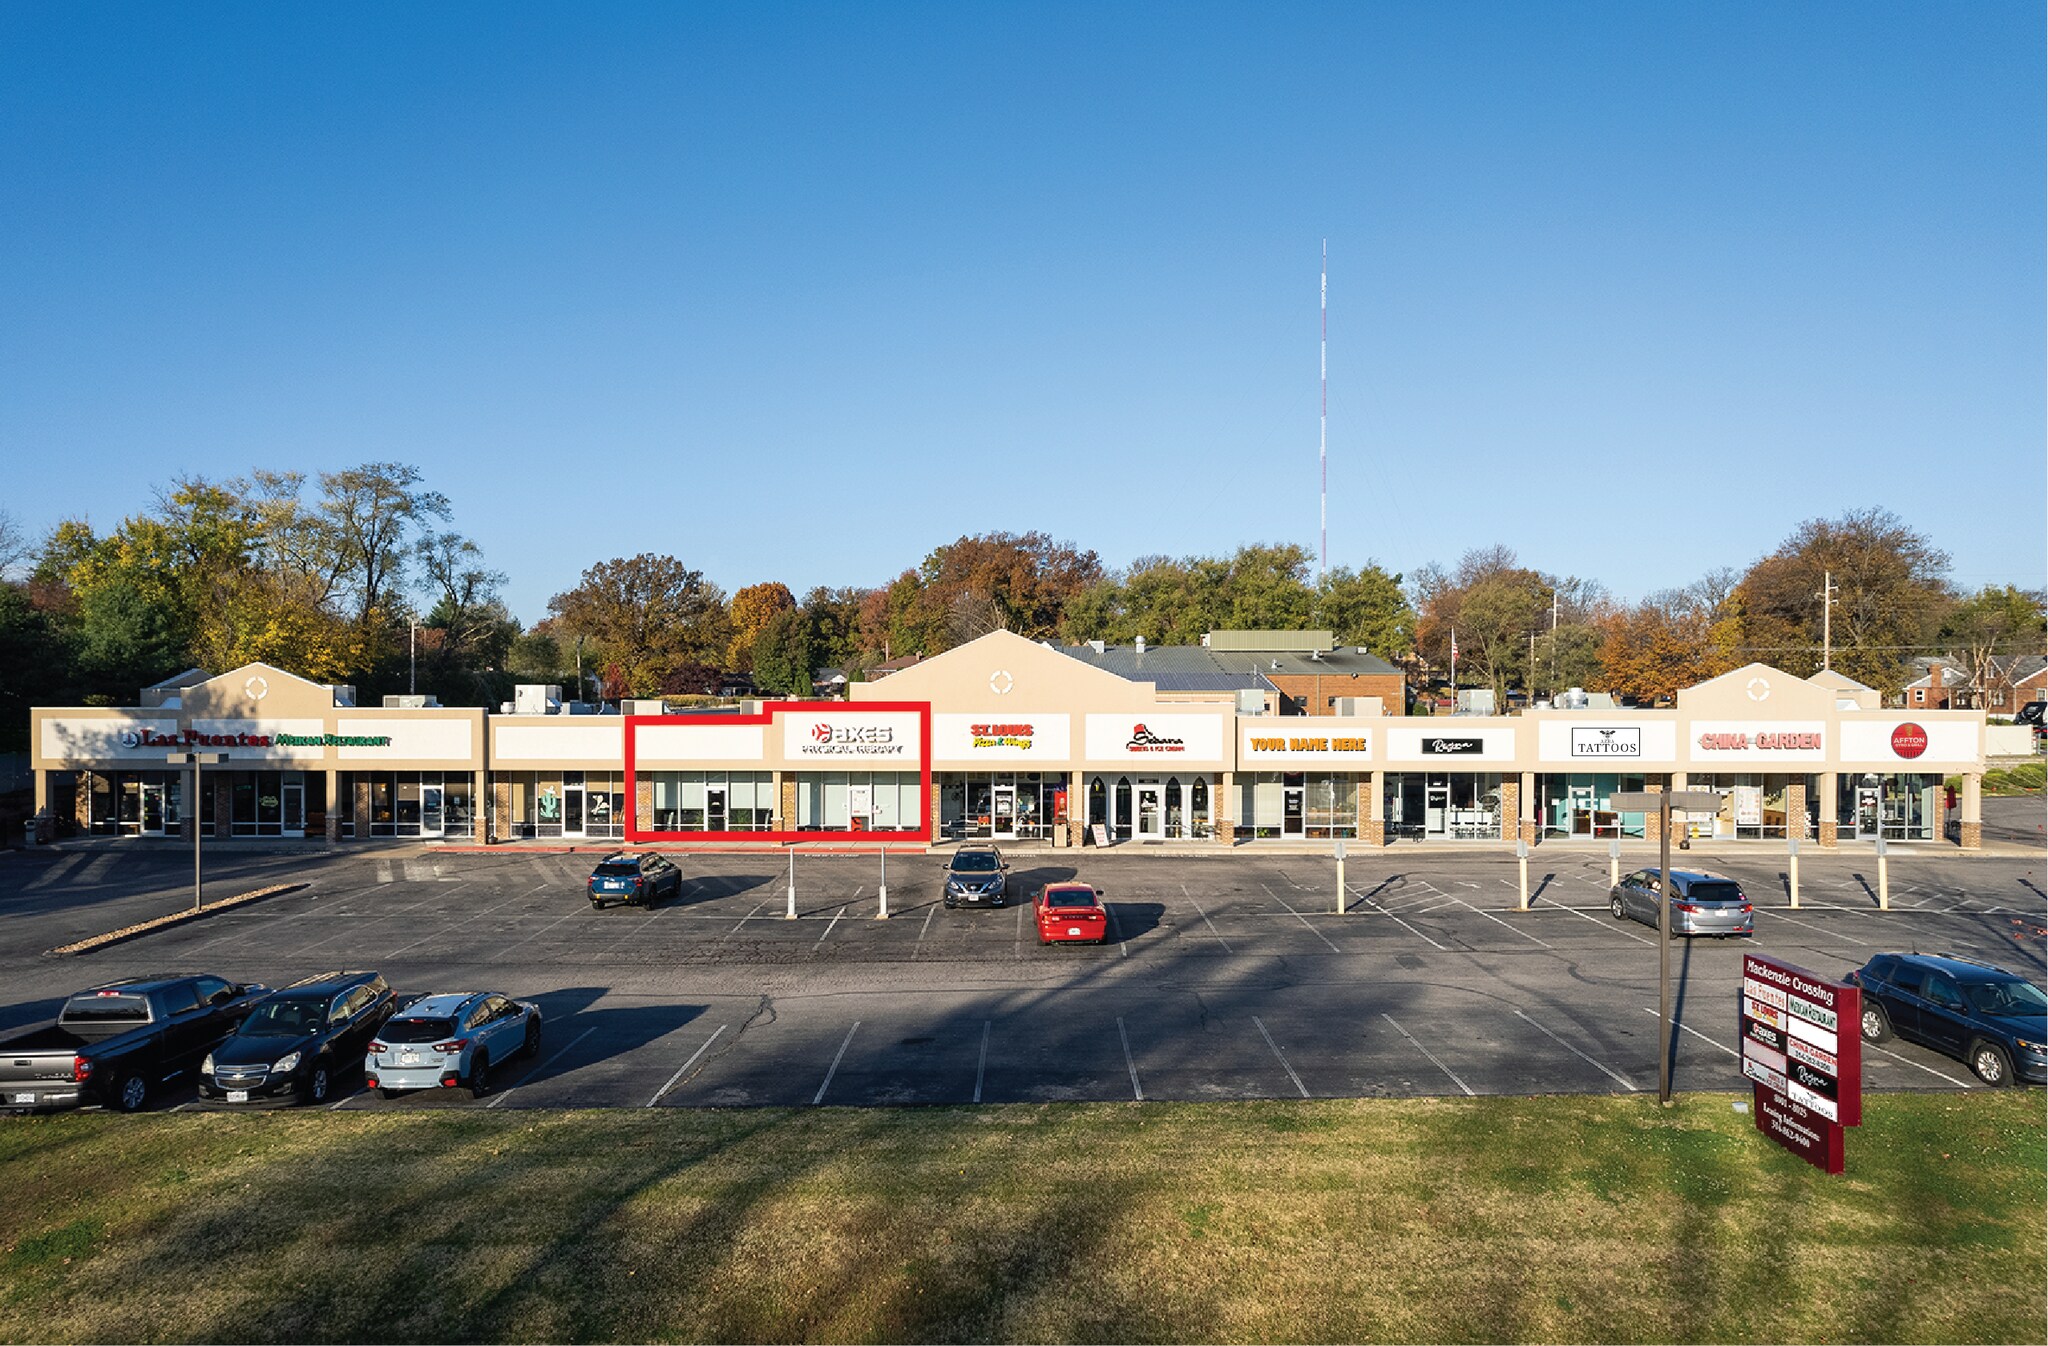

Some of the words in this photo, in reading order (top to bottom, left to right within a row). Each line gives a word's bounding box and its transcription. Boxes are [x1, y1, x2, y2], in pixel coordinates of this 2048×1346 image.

[140, 729, 178, 746] Las
[1250, 738, 1286, 752] YOUR
[1289, 738, 1328, 752] NAME
[1331, 738, 1366, 752] HERE
[1701, 733, 1749, 750] CHINA
[1756, 732, 1821, 750] GARDEN
[1578, 743, 1636, 753] TATTOOS
[1747, 959, 1791, 986] Mackenzie
[1792, 976, 1834, 1006] Crossing
[1789, 1039, 1809, 1053] CHINA
[1791, 1091, 1833, 1118] TATTOOS
